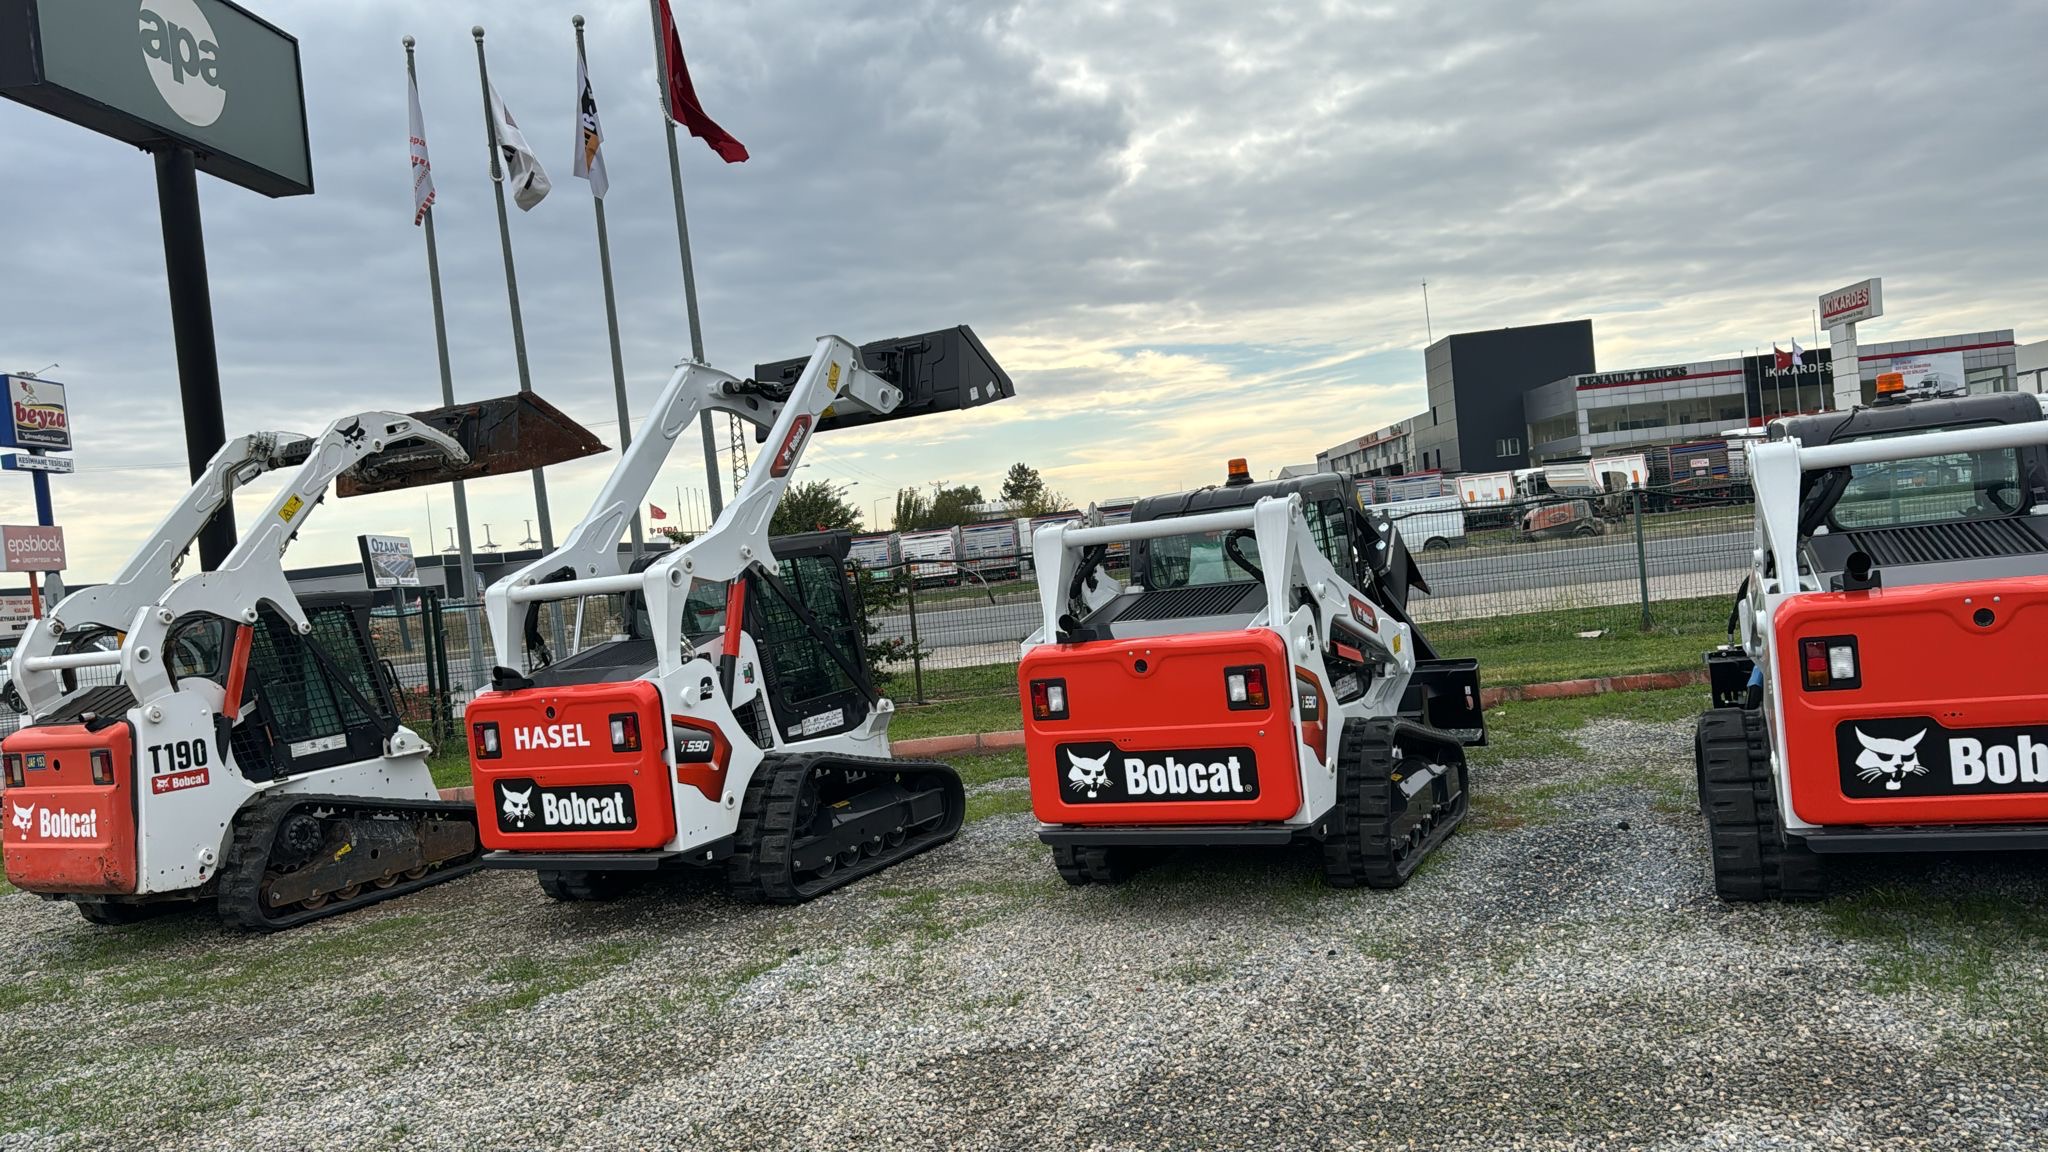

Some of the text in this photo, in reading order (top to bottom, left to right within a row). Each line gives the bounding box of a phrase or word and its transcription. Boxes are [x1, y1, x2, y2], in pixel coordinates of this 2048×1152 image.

[139, 9, 225, 89] apa
[1577, 366, 1687, 386] RENAULT TRUCKS
[14, 401, 66, 430] beyza
[8, 535, 62, 556] epsblock
[514, 722, 592, 751] HASEL
[680, 739, 710, 753] T590
[148, 738, 208, 775] T190
[1949, 734, 2048, 786] Bob
[172, 773, 205, 789] Bobcat
[1124, 755, 1244, 795] Bobcat
[40, 807, 98, 839] Bobcat
[542, 790, 626, 827] Bobcat
